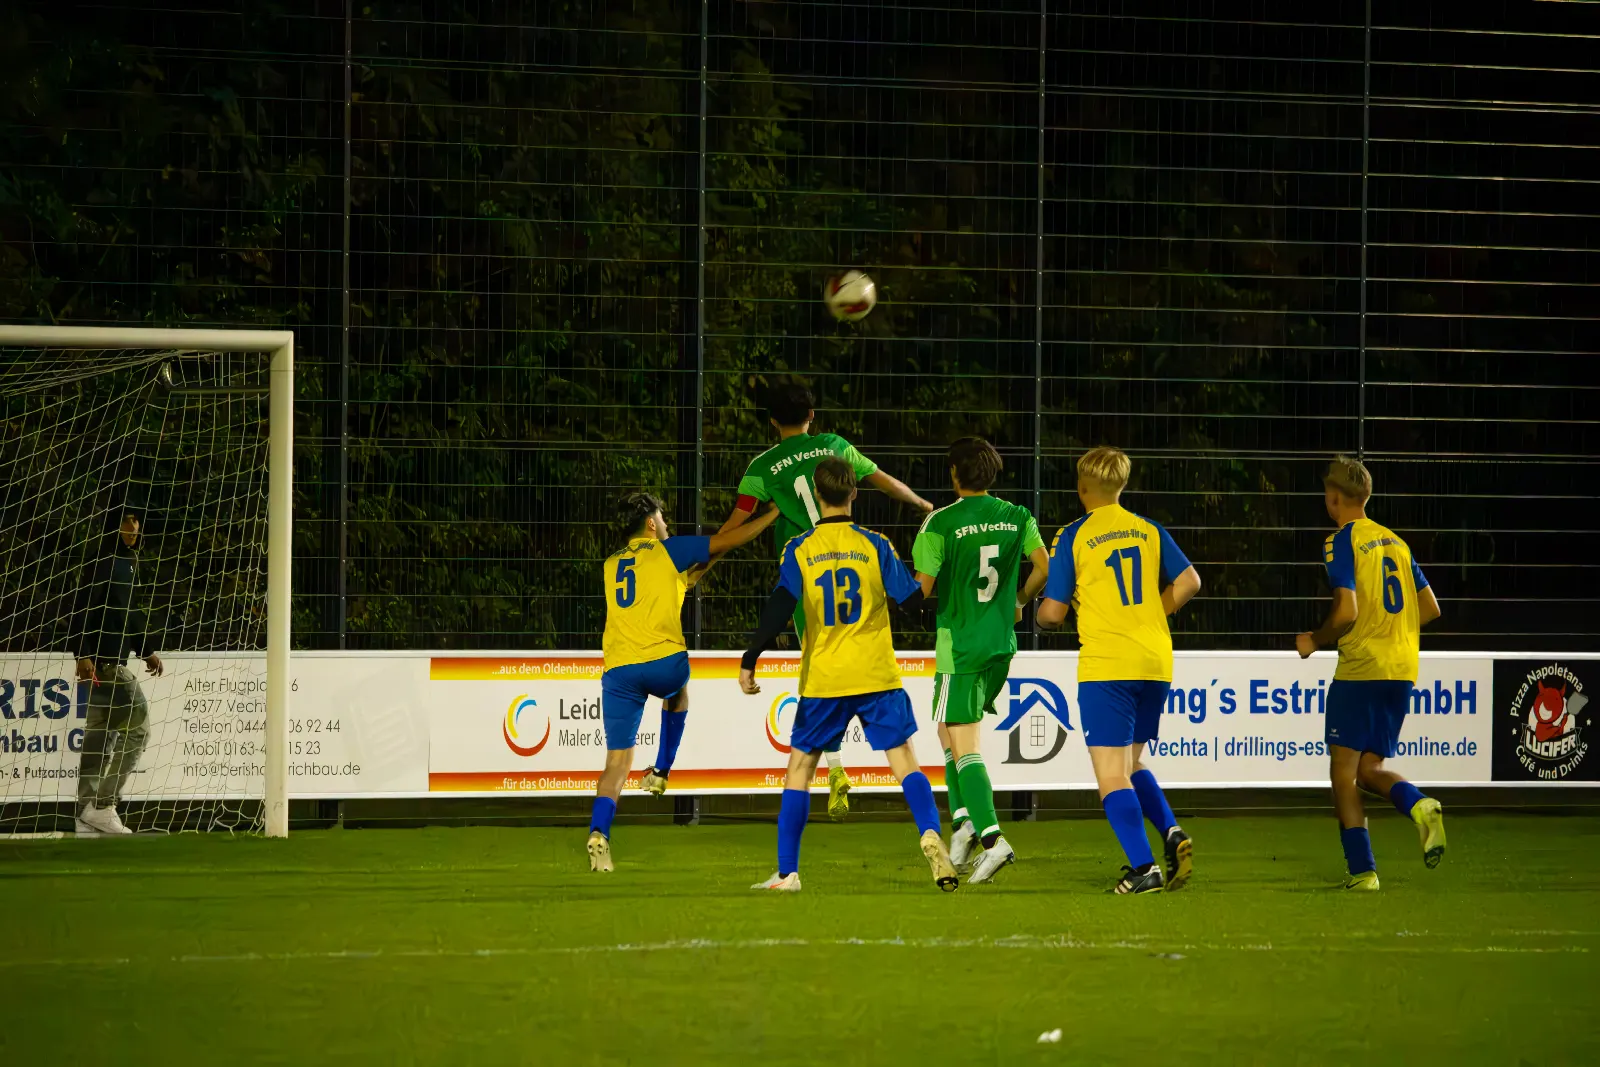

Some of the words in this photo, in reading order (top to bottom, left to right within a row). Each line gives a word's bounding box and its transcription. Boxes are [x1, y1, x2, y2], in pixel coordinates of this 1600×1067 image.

[770, 456, 793, 476] SFN
[793, 447, 835, 463] Vechta
[793, 474, 821, 528] 1
[955, 524, 978, 539] SFN
[980, 522, 1018, 534] Vechta
[616, 556, 637, 608] 5
[977, 545, 1000, 603] 5
[1104, 545, 1143, 606] 17
[1382, 556, 1404, 614] 6
[815, 567, 863, 627] 13
[519, 662, 540, 674] dem
[543, 662, 604, 677] Oldenburger
[781, 661, 800, 672] dem
[899, 660, 925, 672] rland
[184, 678, 215, 692] Alter
[291, 678, 299, 692] 6
[1250, 679, 1326, 714] Estri
[1405, 680, 1477, 714] mbH
[1510, 682, 1529, 717] Pizza
[1526, 662, 1584, 692] Napoletana
[183, 699, 222, 713] 49377
[559, 696, 601, 720] Leid
[183, 719, 232, 734] Telefon
[236, 719, 267, 734] 0444
[307, 719, 321, 733] 92
[326, 719, 341, 733] 44
[558, 729, 591, 747] Maler
[594, 729, 603, 746] &
[183, 741, 220, 756] Mobil
[224, 741, 267, 756] 0163-4
[306, 740, 321, 755] 23
[1148, 738, 1208, 757] Vechta
[1525, 730, 1576, 758] LUCIFER
[1516, 745, 1536, 773] Café
[1538, 767, 1558, 779] und
[1559, 741, 1589, 777] Drinks
[519, 779, 536, 790] das
[861, 772, 898, 784] Münste
